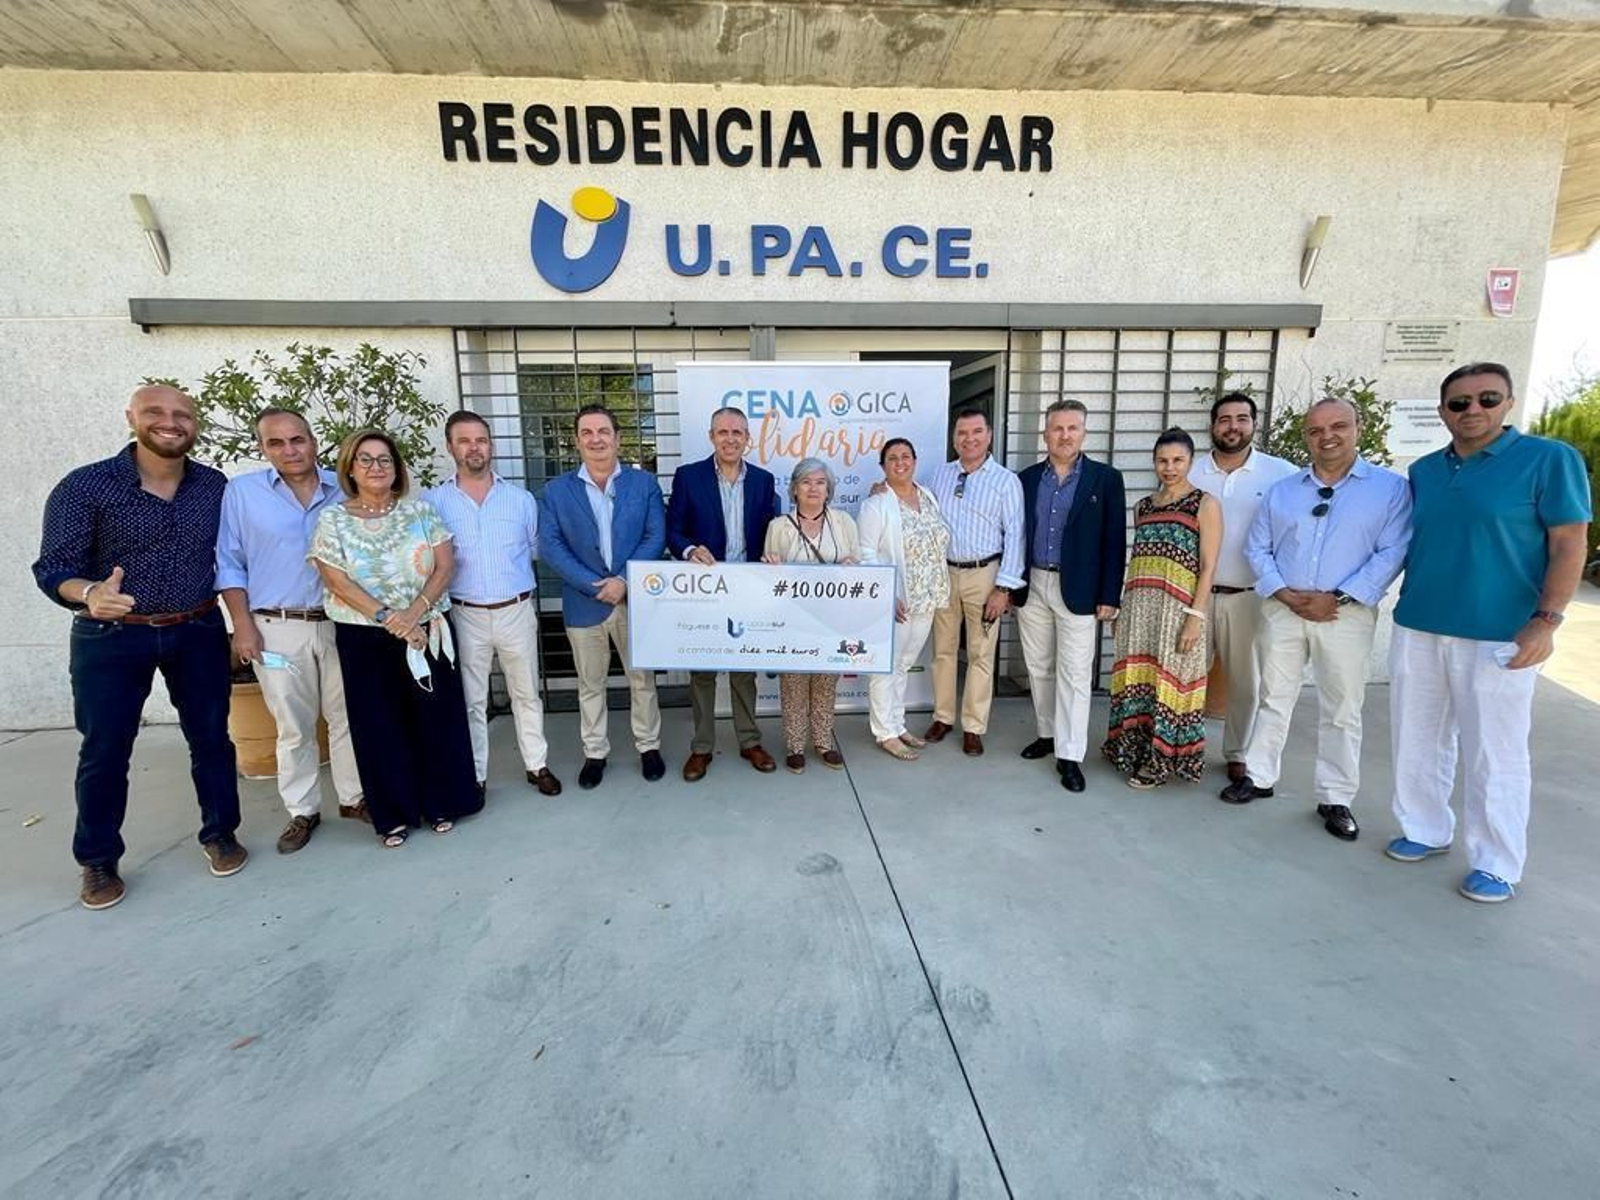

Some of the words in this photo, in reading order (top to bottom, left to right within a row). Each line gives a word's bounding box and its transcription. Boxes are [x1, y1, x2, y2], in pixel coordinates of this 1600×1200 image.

[438, 102, 821, 168] RESIDENCIA
[842, 111, 1054, 171] HOGAR
[665, 224, 730, 277] U.
[881, 227, 989, 278] CE.
[721, 390, 821, 418] CENA
[857, 392, 912, 413] GICA
[672, 573, 729, 594] GICA
